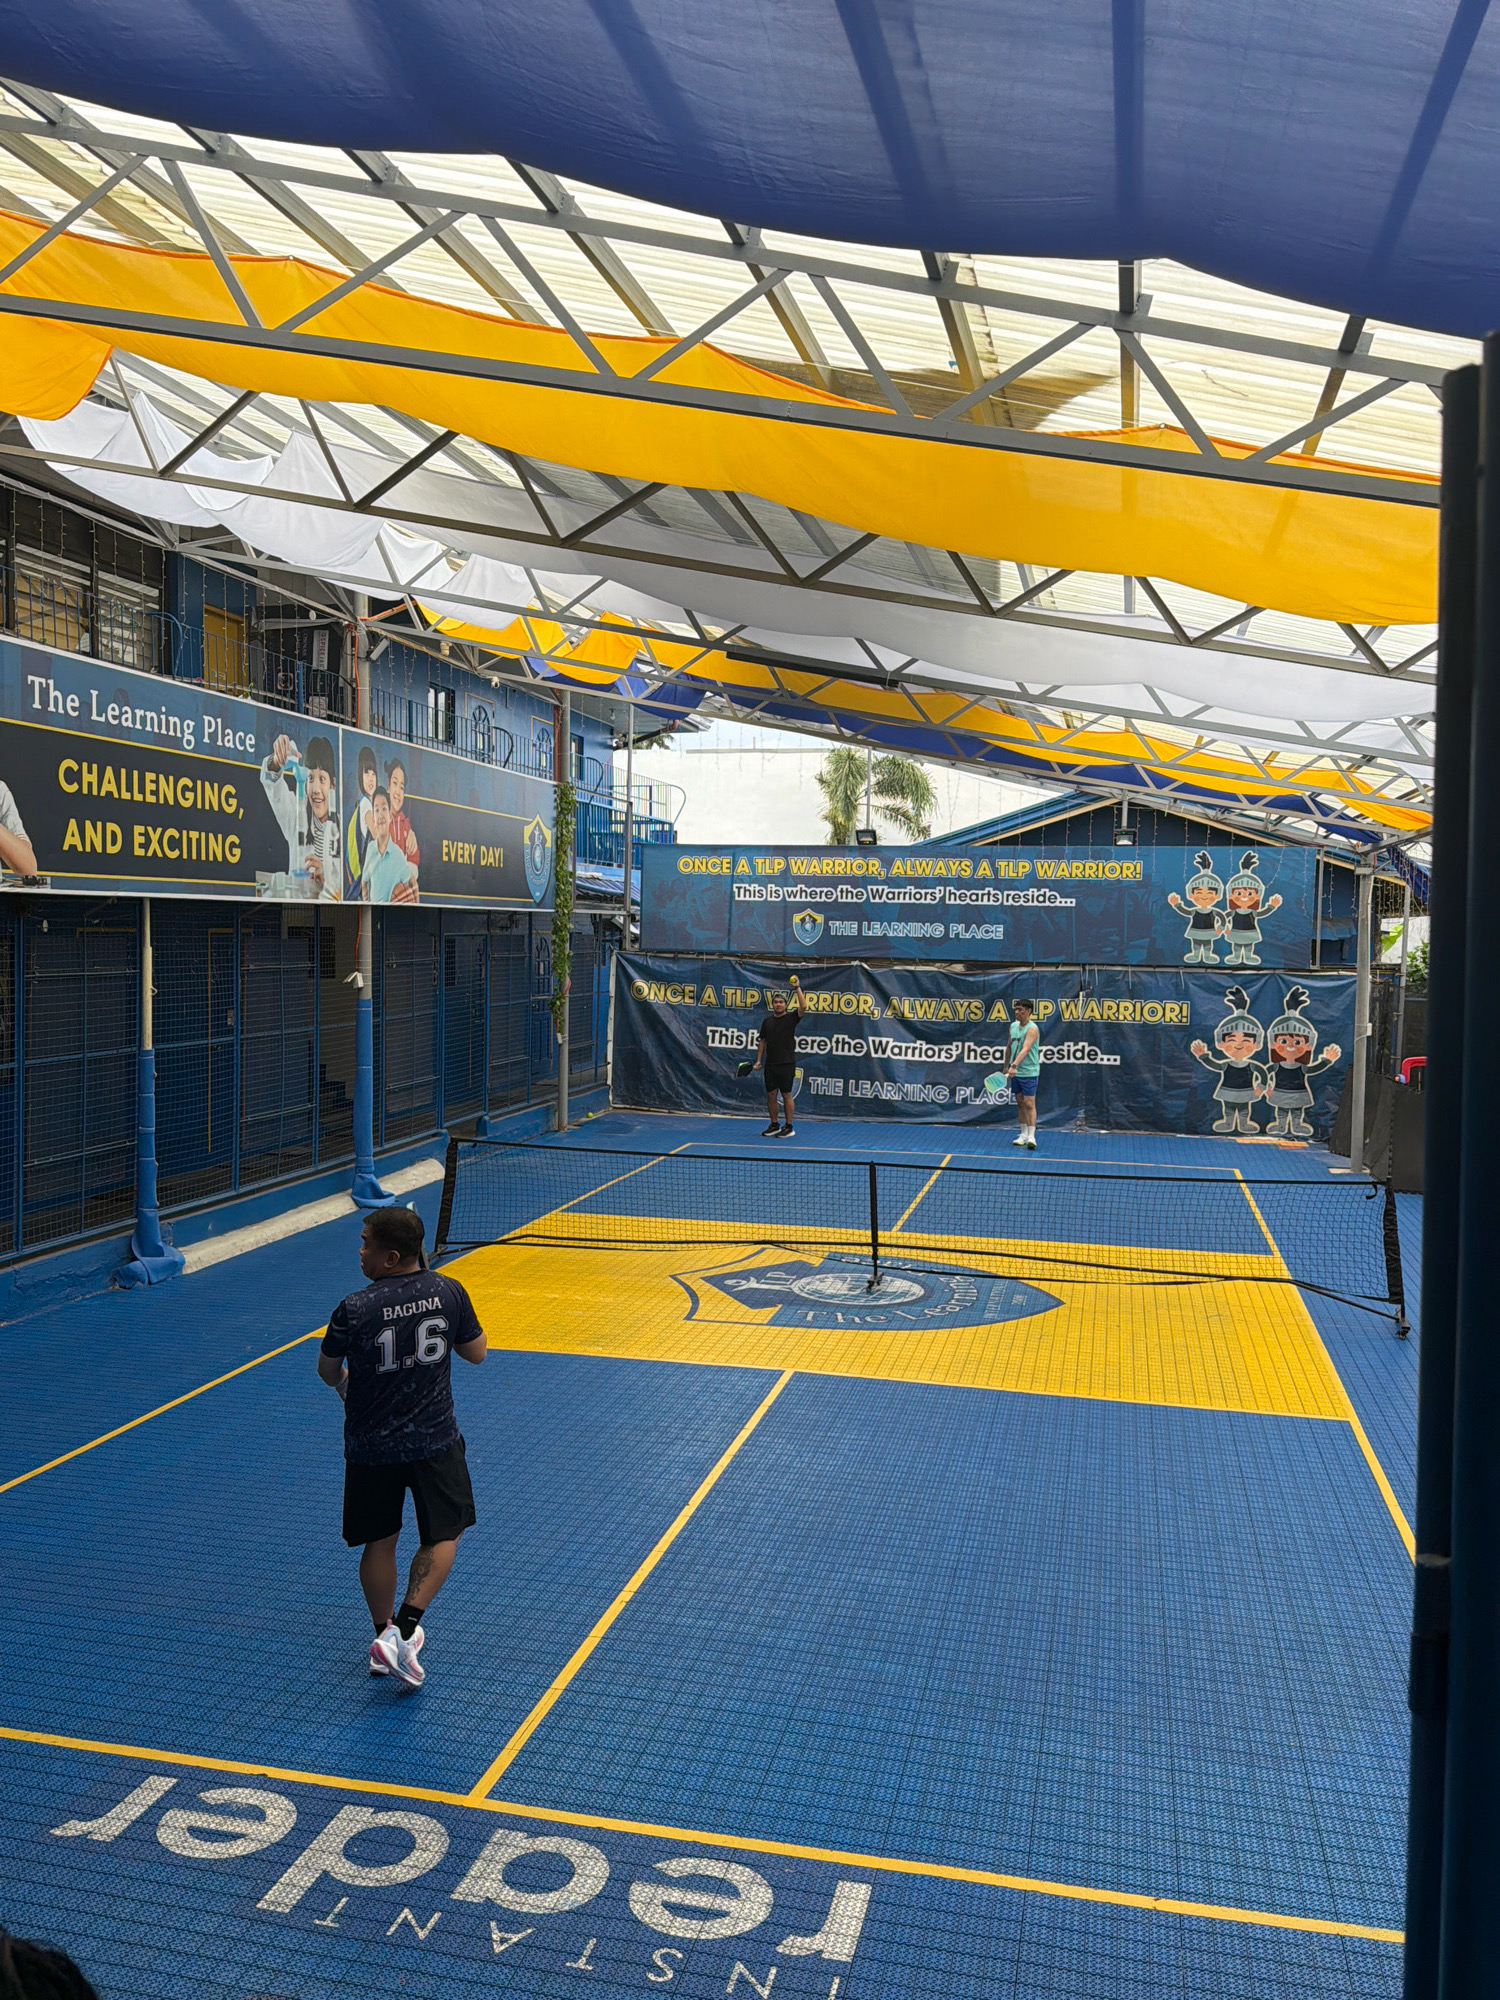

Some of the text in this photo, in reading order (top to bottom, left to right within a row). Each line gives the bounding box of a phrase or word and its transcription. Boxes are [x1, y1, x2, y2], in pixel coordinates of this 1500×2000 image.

[27, 674, 256, 753] The Learning Place
[58, 758, 244, 820] CHALLENGING,
[62, 818, 242, 864] AND EXCITING
[442, 839, 477, 865] EVERY
[480, 845, 504, 868] DAY!
[678, 856, 1143, 880] ONCE A TLP WARRIOR, ALWAYS A TLP WARRIOR!
[733, 884, 766, 900] This
[767, 884, 782, 901] is
[784, 885, 836, 902] where
[837, 885, 867, 902] the
[946, 887, 1001, 905] hearts
[1003, 888, 1076, 907] reside...
[829, 921, 858, 936] THE
[862, 921, 945, 938] LEARNING
[950, 923, 1003, 939] PLACE
[631, 980, 697, 1005] ONCE
[699, 984, 720, 1008] A
[722, 986, 760, 1009] TLP
[883, 997, 985, 1022] ALWAYS
[987, 999, 1010, 1022] A
[1059, 999, 1190, 1025] WARRIOR!
[707, 1027, 745, 1048] This
[831, 1034, 867, 1056] the
[963, 1042, 1004, 1063] hea
[809, 1077, 843, 1096] THE
[848, 1079, 949, 1103] LEARNING
[382, 1297, 442, 1320] BAGUNA
[797, 1309, 890, 1324] The
[893, 1275, 979, 1321] Learning
[375, 1315, 449, 1374] 1.6
[51, 1774, 872, 1962] reader
[313, 1897, 840, 2000] INSTANT
